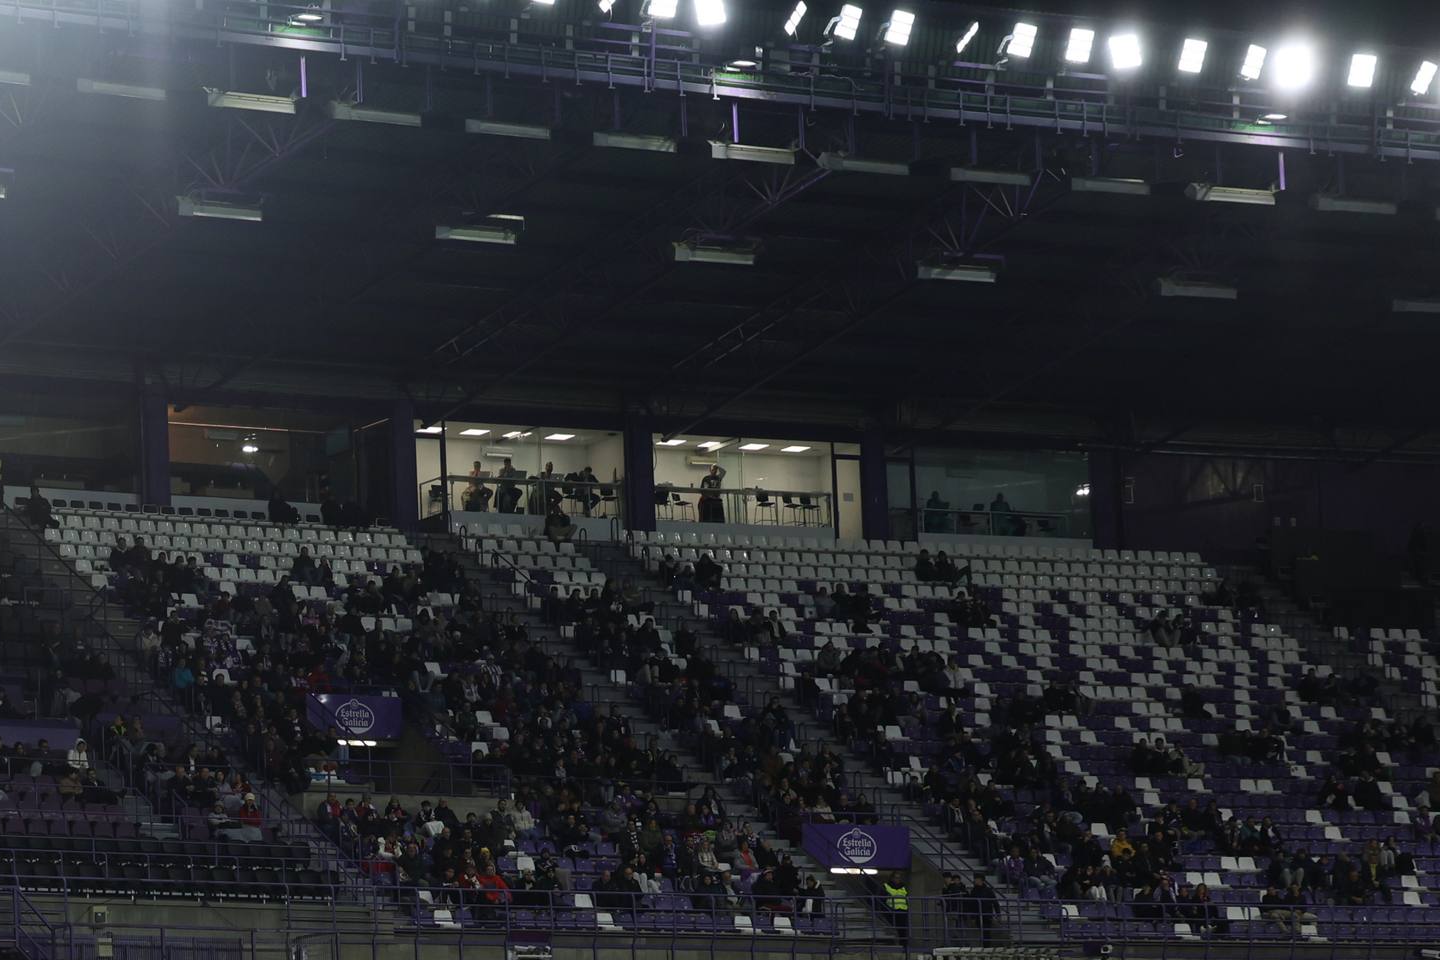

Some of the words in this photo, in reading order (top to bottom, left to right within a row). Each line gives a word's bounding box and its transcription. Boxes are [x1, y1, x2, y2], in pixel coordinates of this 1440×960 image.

[340, 708, 369, 718] Estrella
[342, 717, 369, 727] Galicia
[842, 838, 872, 847] Estrella
[844, 846, 871, 856] Galicia
